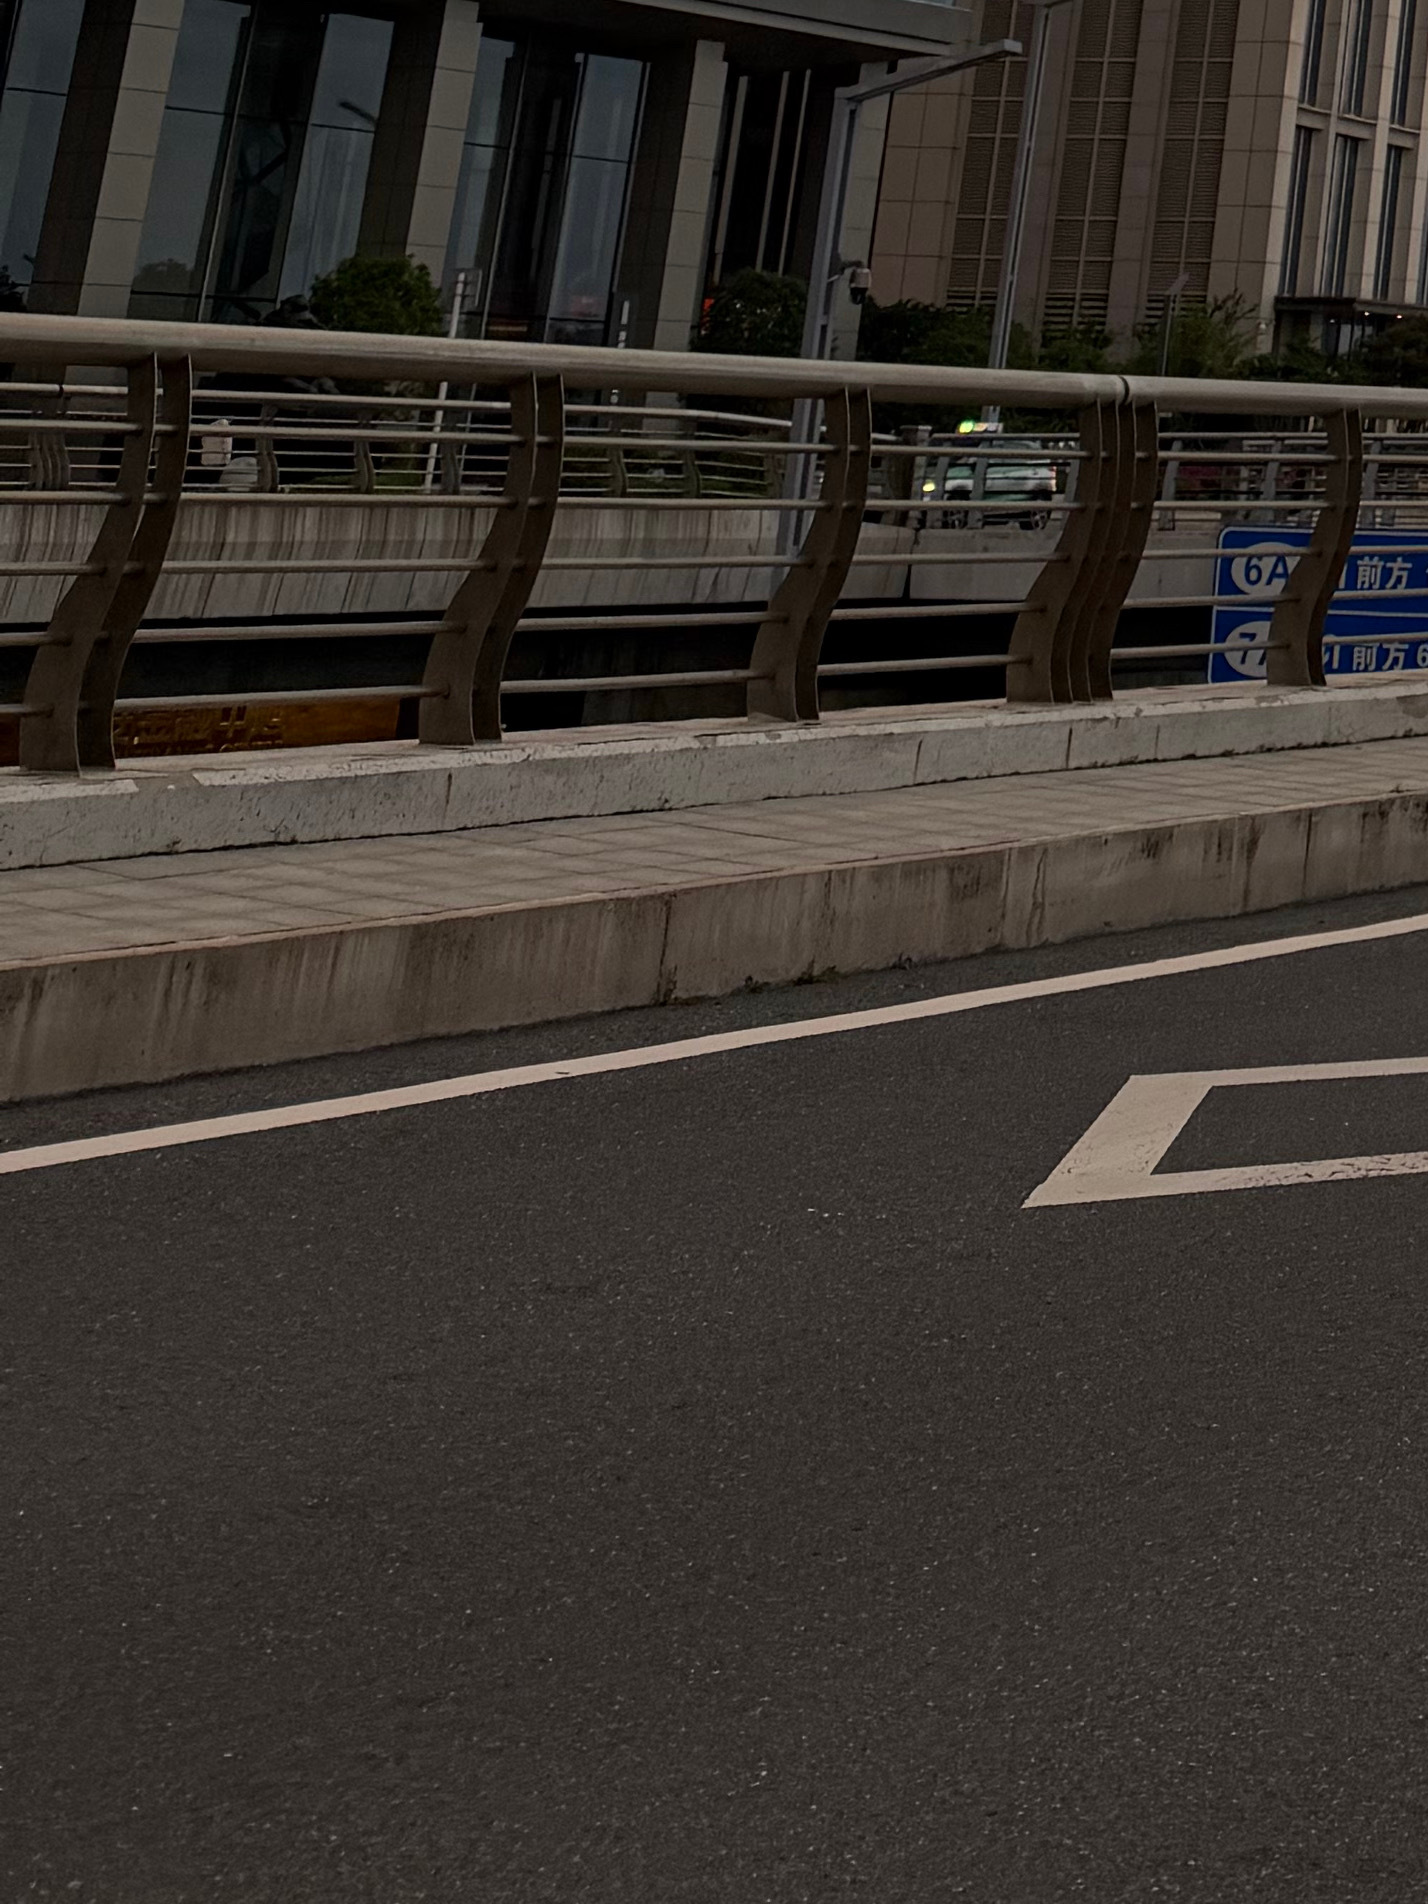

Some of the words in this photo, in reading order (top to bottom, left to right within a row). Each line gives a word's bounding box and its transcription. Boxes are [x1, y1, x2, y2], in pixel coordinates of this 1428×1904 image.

[1244, 555, 1289, 586] 6A
[1357, 556, 1413, 590] 前方
[1239, 632, 1267, 666] 7
[1352, 642, 1409, 671] 前方
